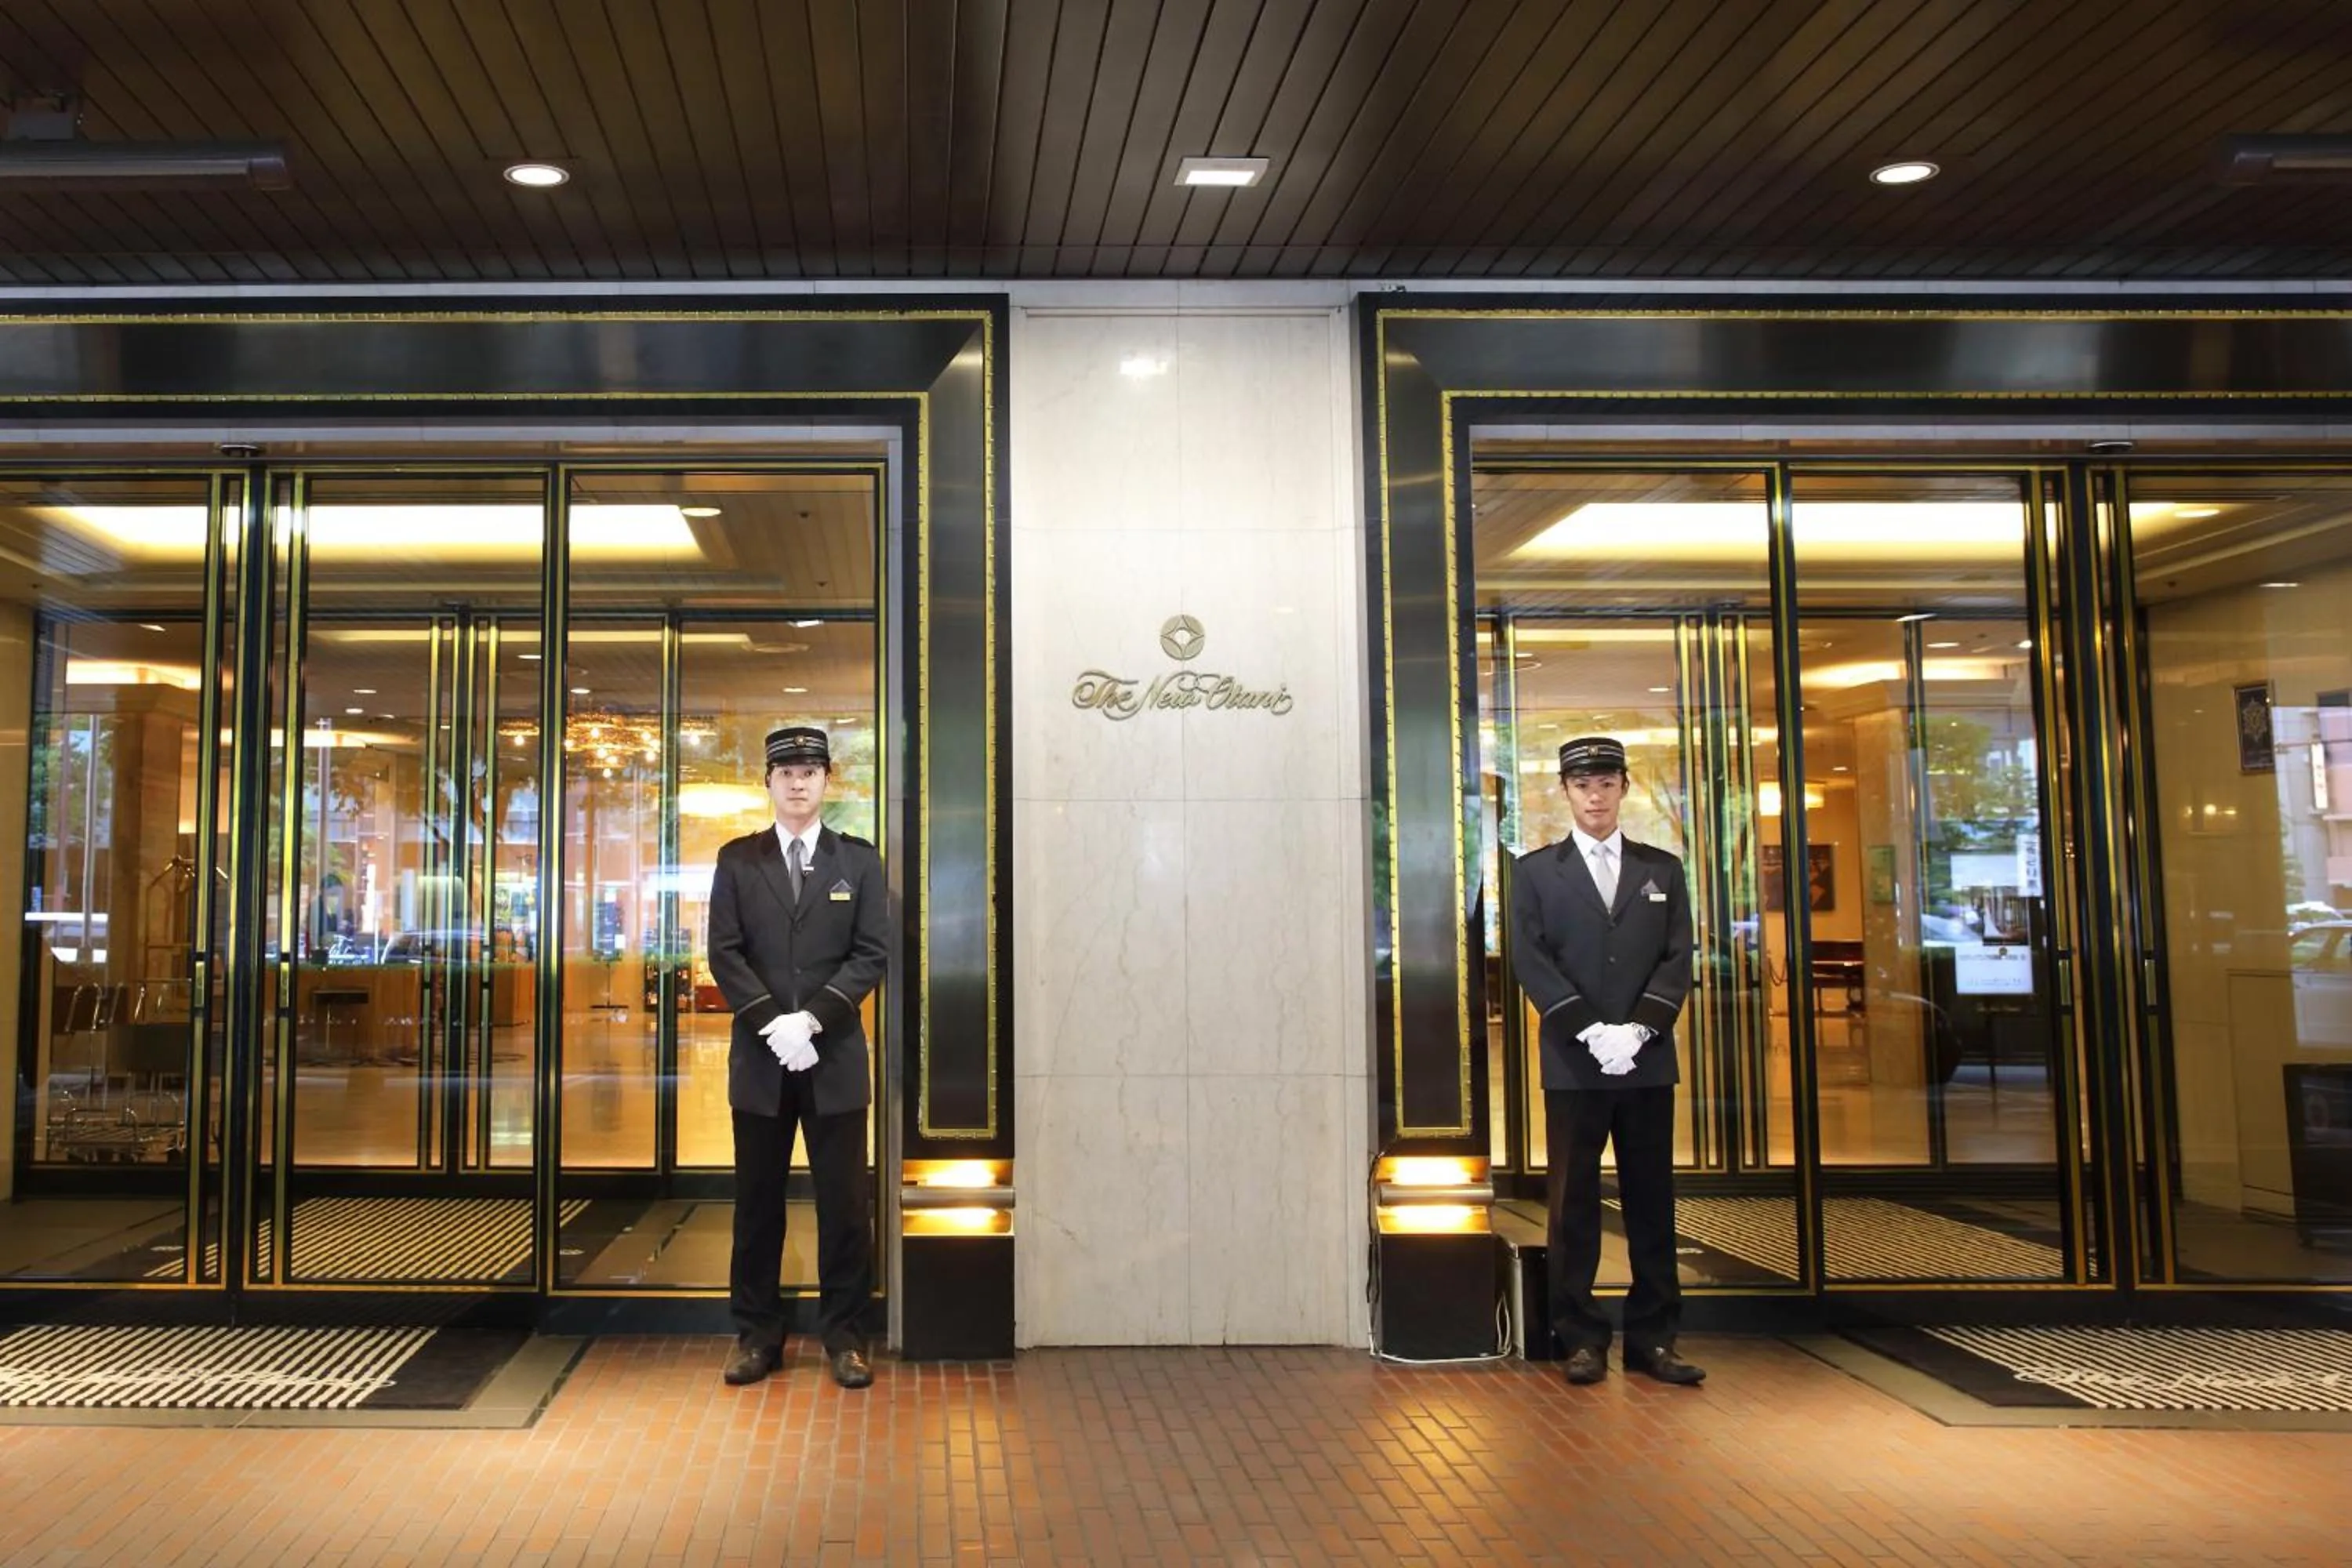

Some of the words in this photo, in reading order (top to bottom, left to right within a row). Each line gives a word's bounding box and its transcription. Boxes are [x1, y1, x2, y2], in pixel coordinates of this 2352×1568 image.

[1072, 670, 1140, 710] The
[1102, 670, 1203, 721] New
[1196, 673, 1294, 717] Otani
